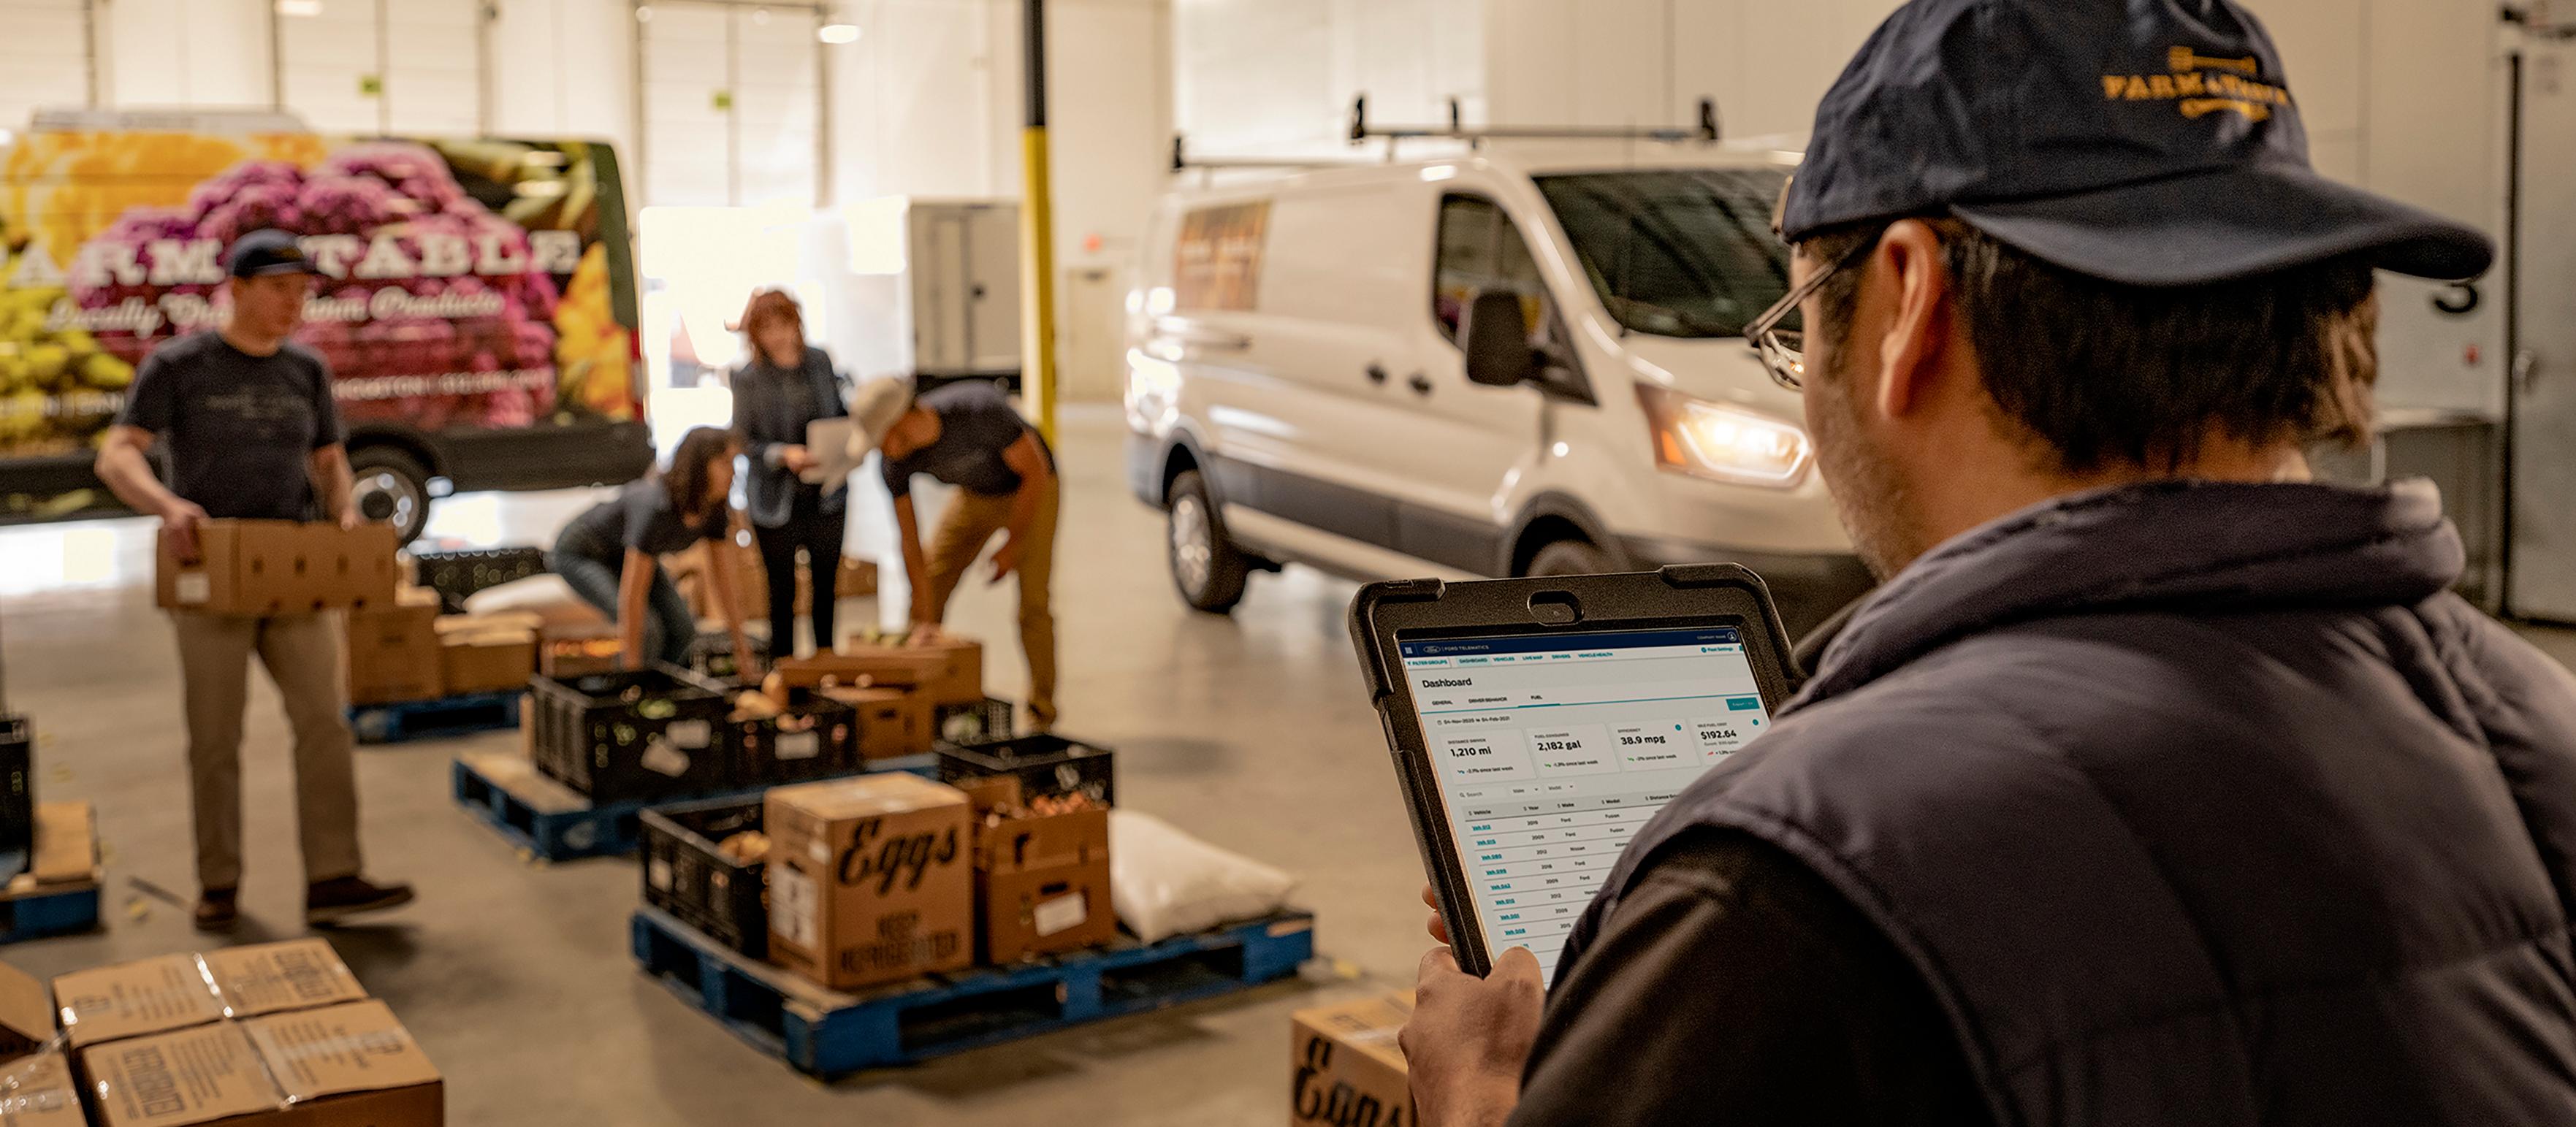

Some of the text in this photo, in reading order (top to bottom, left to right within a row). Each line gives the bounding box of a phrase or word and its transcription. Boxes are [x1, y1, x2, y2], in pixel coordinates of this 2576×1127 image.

[294, 229, 582, 280] TABLE
[0, 237, 228, 289] ARM
[1422, 678, 1472, 688] Dashboard
[1620, 735, 1666, 746] 38.9 mpg
[1700, 729, 1737, 741] $192.64
[1537, 739, 1582, 752] 2,182 gal
[1450, 746, 1492, 758] 1,210 mi
[837, 817, 958, 897] Eggs
